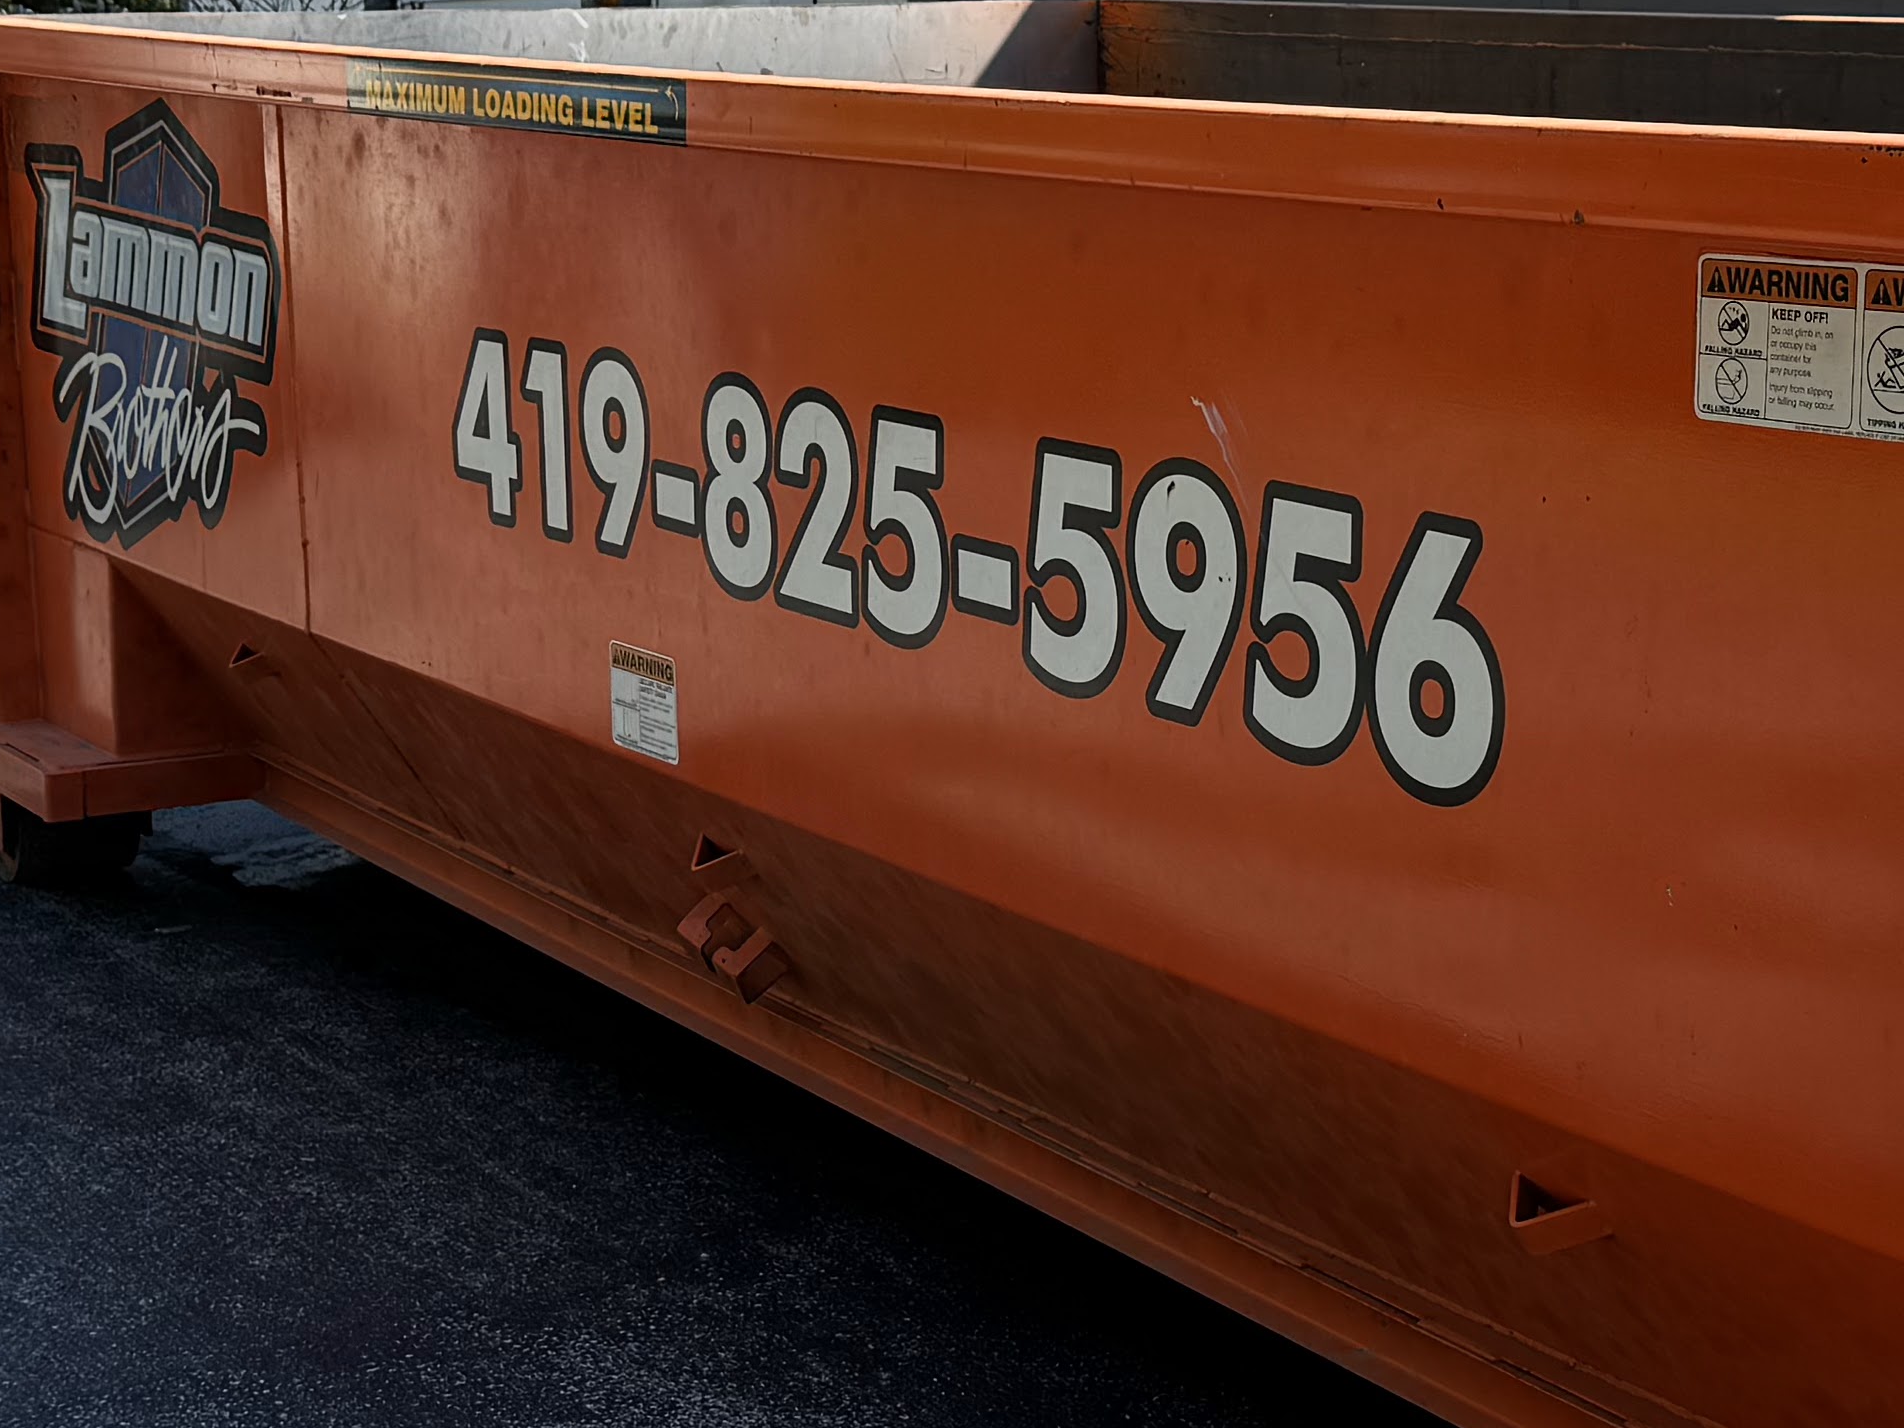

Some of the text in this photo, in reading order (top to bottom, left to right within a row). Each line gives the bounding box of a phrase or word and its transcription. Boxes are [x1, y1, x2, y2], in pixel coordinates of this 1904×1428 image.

[365, 79, 659, 134] MAXIMUM LOADING LEVEL
[42, 176, 268, 347] Lammon
[1726, 267, 1849, 302] WARNING
[1771, 326, 1780, 335] Do
[1772, 308, 1828, 324] KEEP OFF!
[59, 335, 261, 524] Brothers
[451, 328, 1504, 806] 419-825-5956
[619, 650, 673, 681] WARNING
